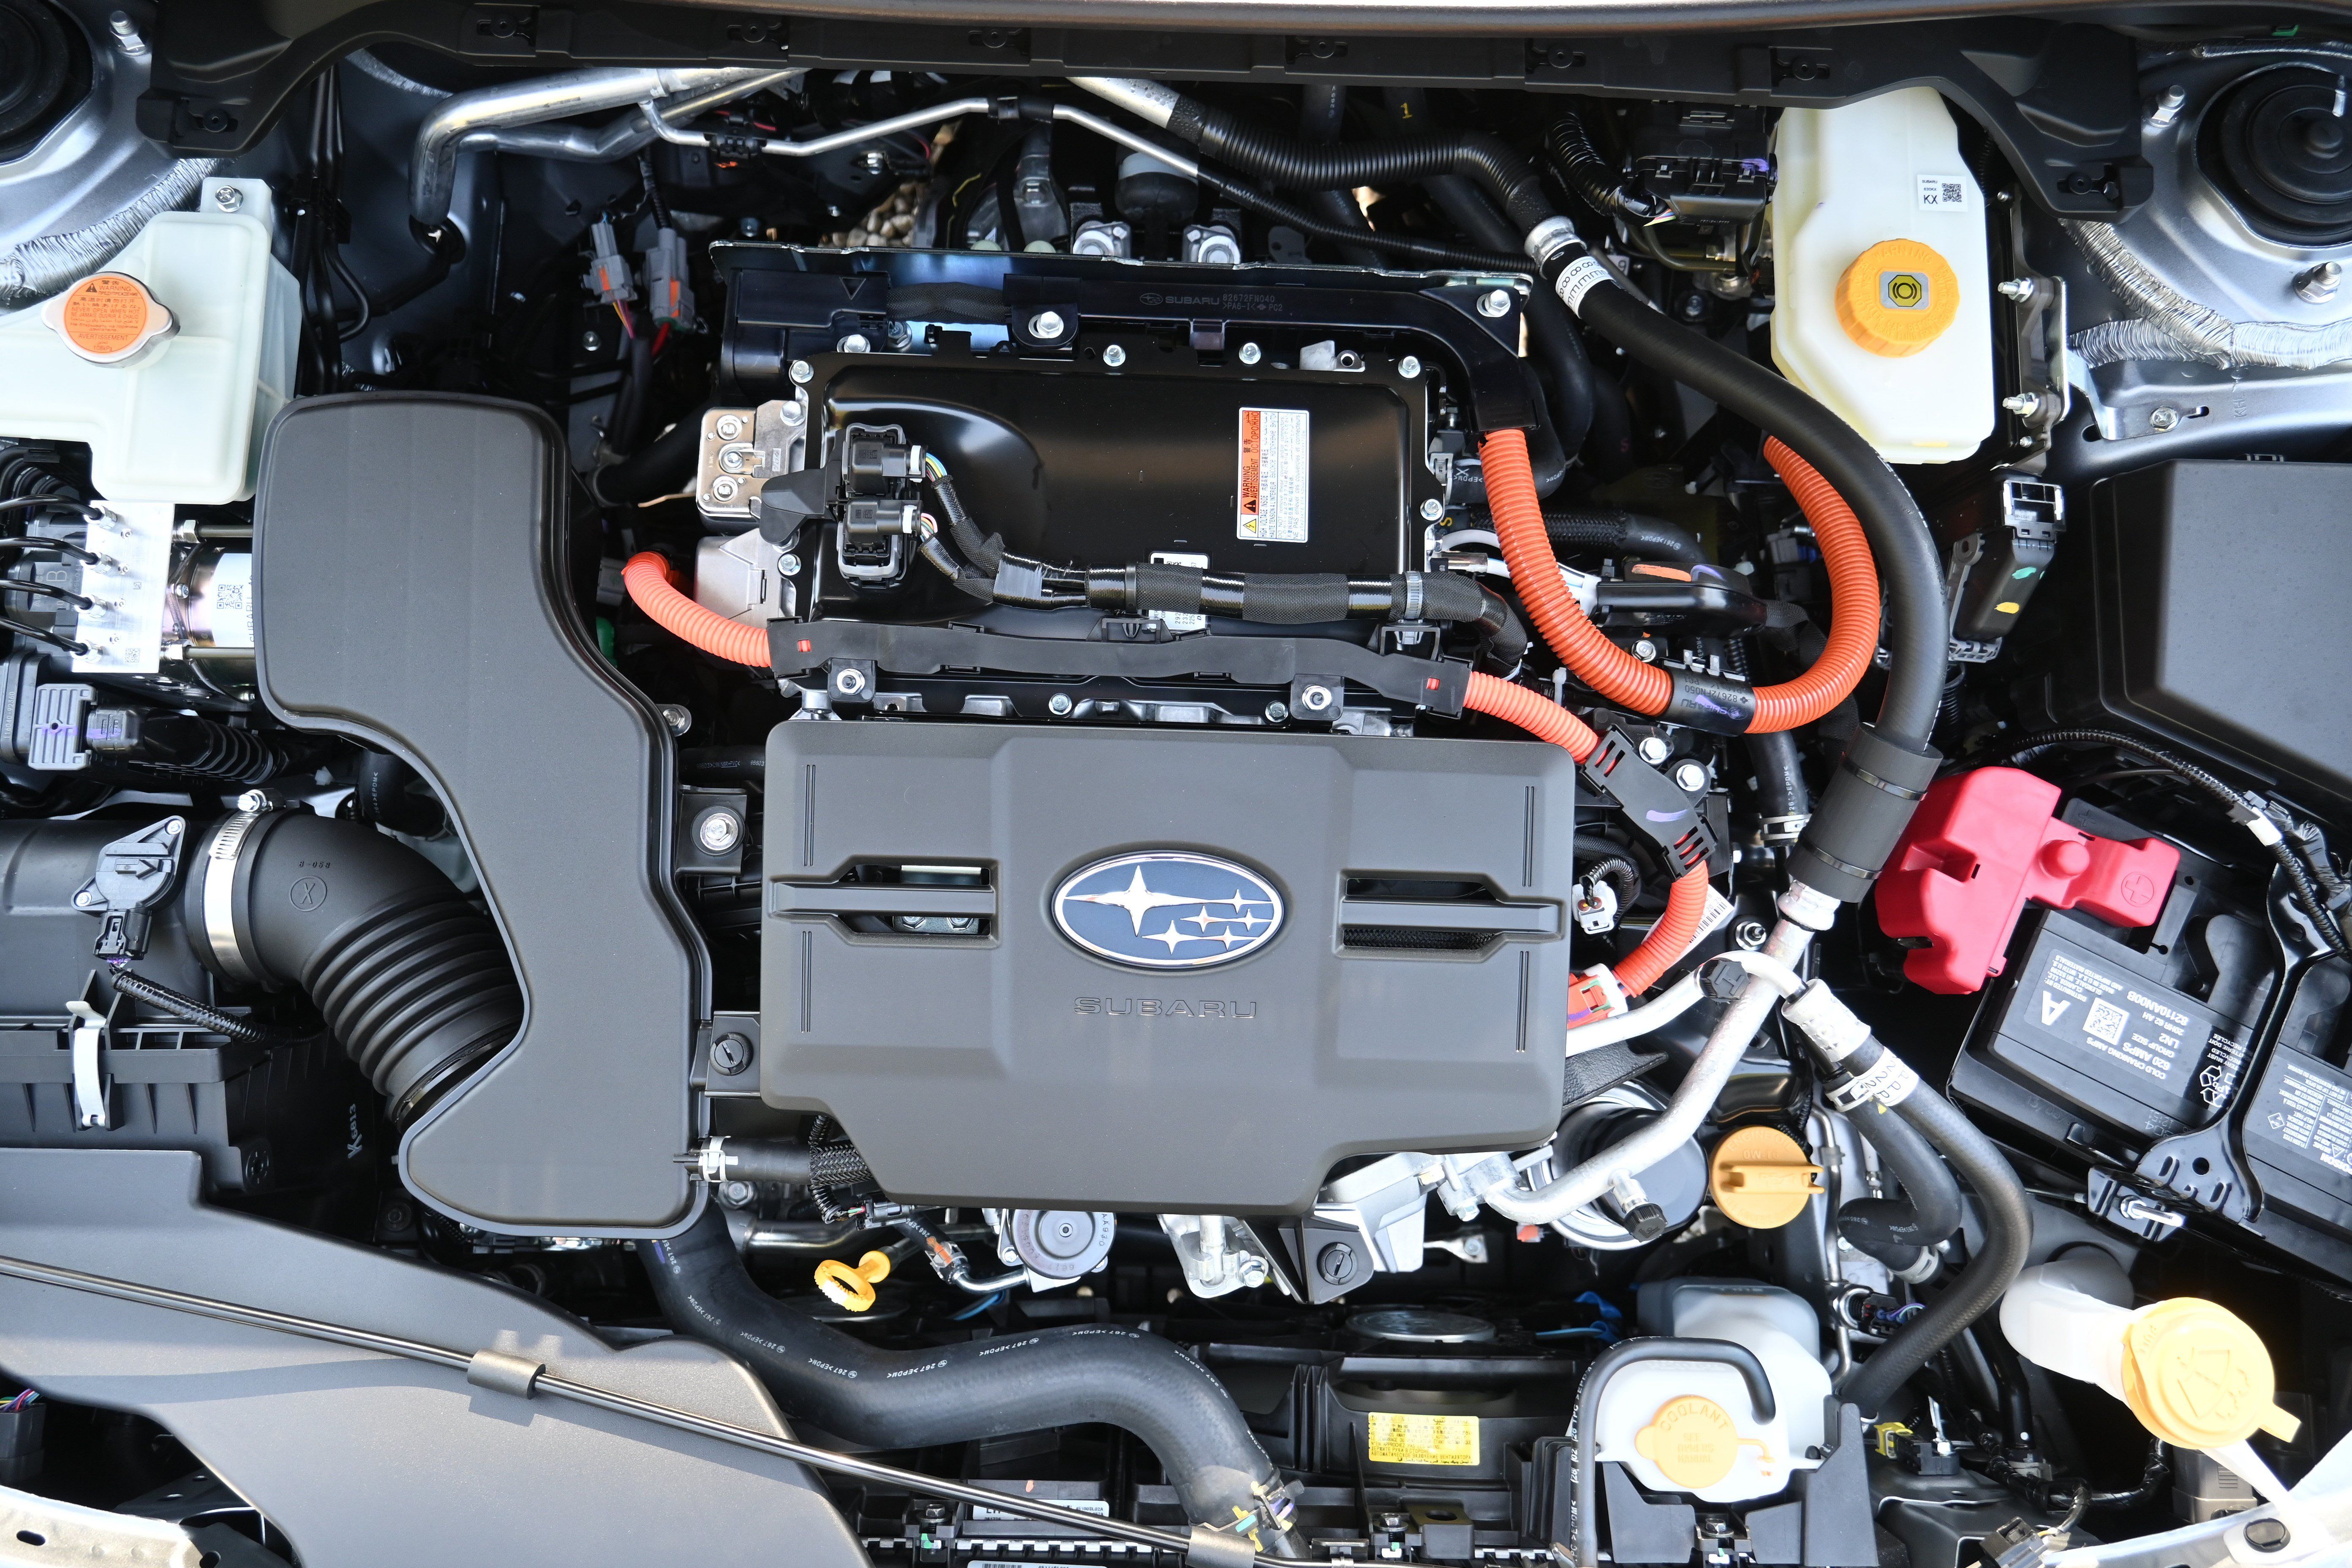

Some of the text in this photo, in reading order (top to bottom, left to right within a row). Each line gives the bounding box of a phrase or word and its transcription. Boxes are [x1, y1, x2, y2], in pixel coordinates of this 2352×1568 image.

[1400, 102, 1413, 119] 1
[1924, 195, 1938, 204] KX
[1873, 243, 1937, 265] WARNING
[1165, 294, 1275, 305] SUBARU 82672FN040
[1269, 304, 1283, 312] PC2
[1863, 294, 1884, 323] FILLER
[1907, 312, 1938, 335] BEFORE
[1933, 271, 1947, 314] REMOVING
[1242, 439, 1250, 498] WARNING 警告
[1250, 458, 1258, 498] AVERTISSEMENT
[46, 570, 68, 582] B
[1684, 684, 1738, 702] 82672FN050
[4, 690, 16, 739] 116040-92360
[2054, 954, 2123, 991] AND IMPORTED MATERIALS
[2061, 965, 2076, 976] WITH
[2043, 977, 2087, 1002] DISTRIBUTED BY:
[2099, 982, 2115, 994] MADE
[1073, 997, 1258, 1019] SUBARU
[2032, 989, 2071, 1030] A
[2126, 989, 2190, 1026] 82110AN00B
[2141, 1011, 2185, 1036] 20HR 62 AH
[2131, 1032, 2176, 1059] GROUP SIZE
[2158, 1032, 2180, 1049] LN2
[2208, 1037, 2222, 1047] DOIT
[2213, 1033, 2242, 1050] RECYCLÉE
[2085, 1036, 2167, 1081] COLD CRANKING AMPS
[2121, 1041, 2171, 1071] 620 AMPS
[2207, 1052, 2224, 1063] MUST
[2210, 1080, 2225, 1093] Pb
[2308, 1074, 2332, 1089] RENVERSER
[2300, 1093, 2321, 1106] CONSULTEZ
[2328, 1090, 2338, 1098] NOT
[2286, 1114, 2312, 1130] GET MEDICAL
[2303, 1115, 2314, 1124] HELP
[2282, 1127, 2307, 1141] IMMEDIATELY
[2282, 1133, 2305, 1148] FLUSH EYES
[2300, 1128, 2310, 1136] WITH
[1726, 1130, 1794, 1153] ENGINE OIL
[1743, 1149, 1778, 1160] 0W-16
[740, 1331, 777, 1350] 267>EPDM<
[978, 1340, 1028, 1357] 267>EPDM<
[808, 1358, 848, 1376] 267>EPDM<
[886, 1363, 937, 1379] 267>EPDM<
[1660, 1402, 1729, 1431] COOLANT
[1683, 1432, 1701, 1442] SEE
[1677, 1454, 1714, 1464] MANUAL
